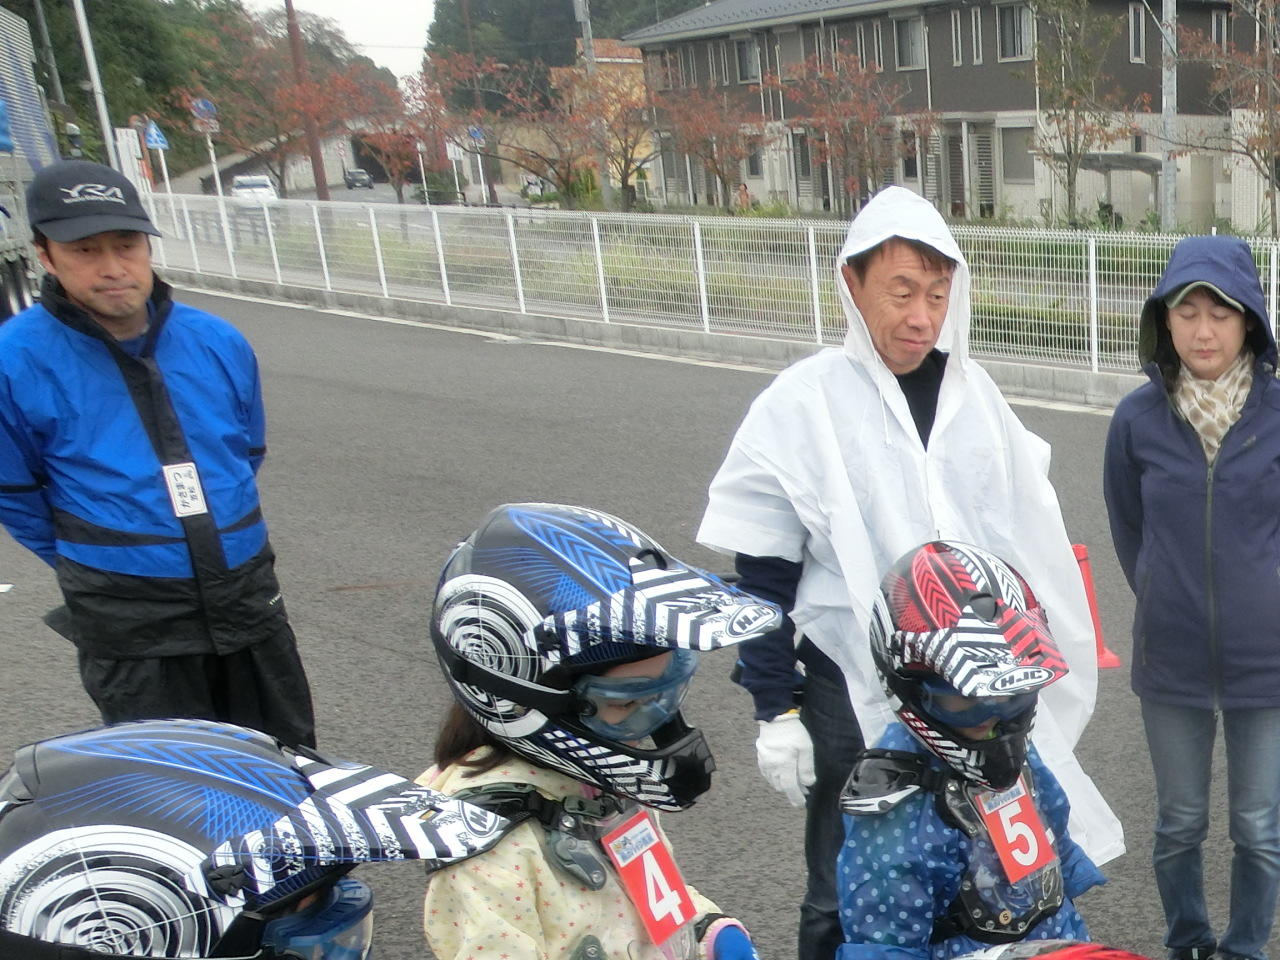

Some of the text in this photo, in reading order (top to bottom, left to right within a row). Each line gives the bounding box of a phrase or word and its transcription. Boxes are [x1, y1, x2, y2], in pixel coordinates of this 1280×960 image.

[1001, 670, 1042, 688] HJC
[998, 800, 1039, 866] 5
[642, 849, 685, 926] 4
